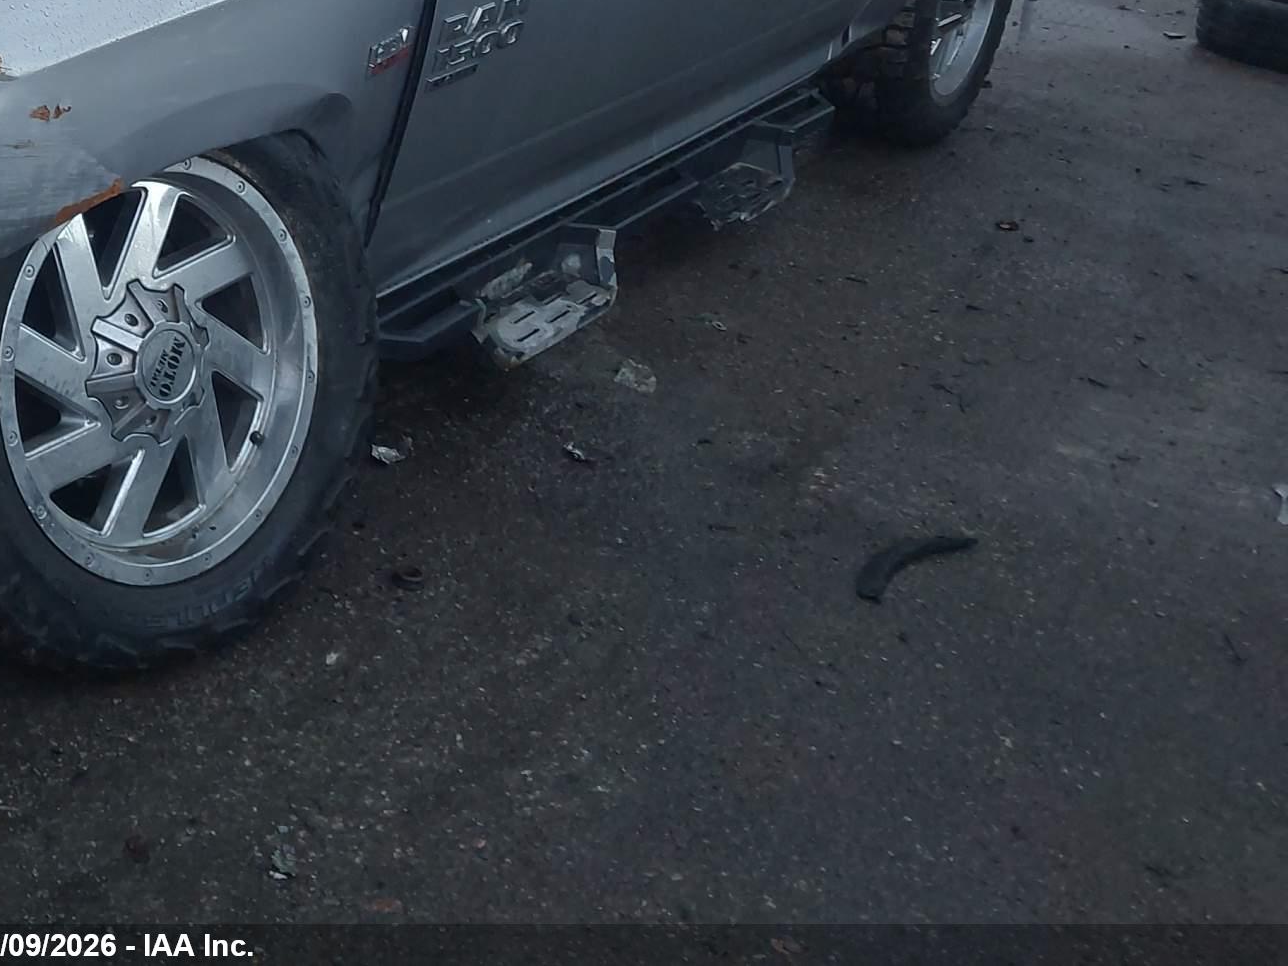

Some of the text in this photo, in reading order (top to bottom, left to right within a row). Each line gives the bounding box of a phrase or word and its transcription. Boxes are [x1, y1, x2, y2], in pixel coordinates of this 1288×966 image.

[430, 20, 524, 76] 1500
[149, 348, 168, 388] METAL
[158, 335, 187, 397] MOTO
